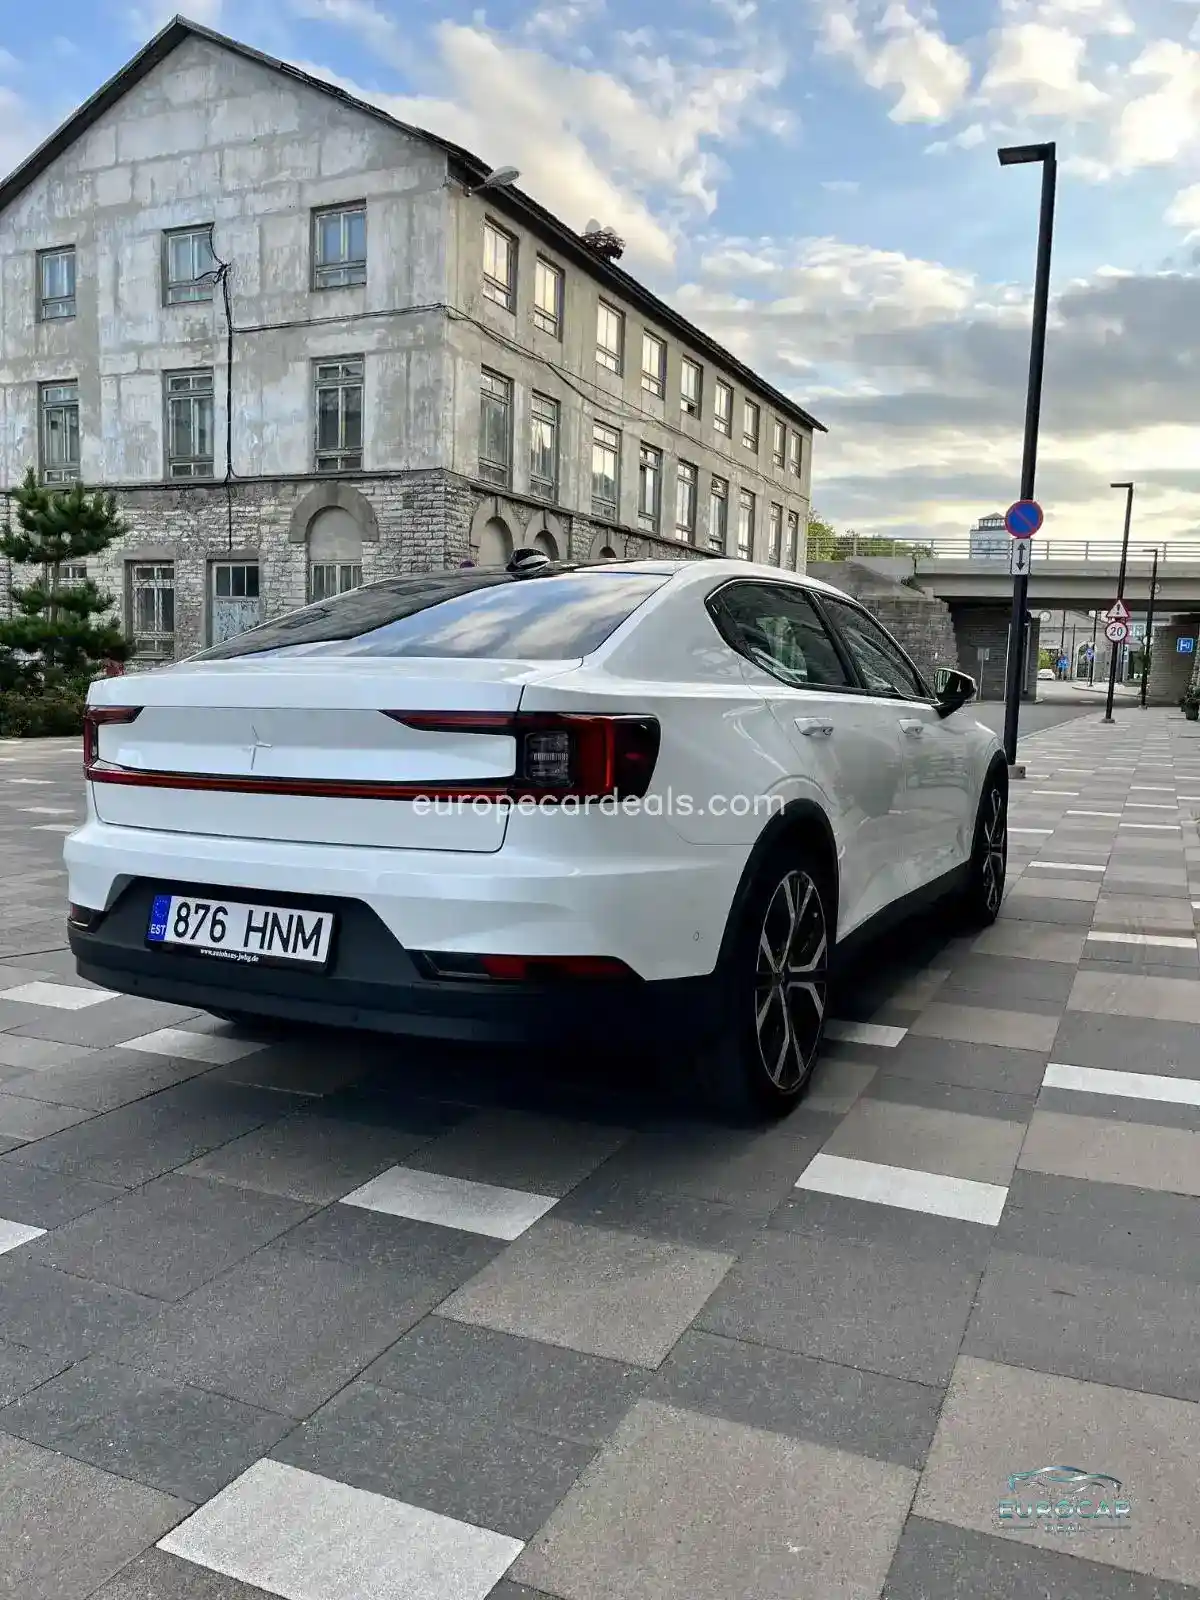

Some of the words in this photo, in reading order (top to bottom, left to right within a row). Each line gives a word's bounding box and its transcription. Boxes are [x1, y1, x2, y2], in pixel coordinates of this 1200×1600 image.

[1109, 626, 1123, 637] 20
[150, 923, 166, 935] EST
[173, 901, 229, 943] 876
[243, 909, 324, 957] HNM
